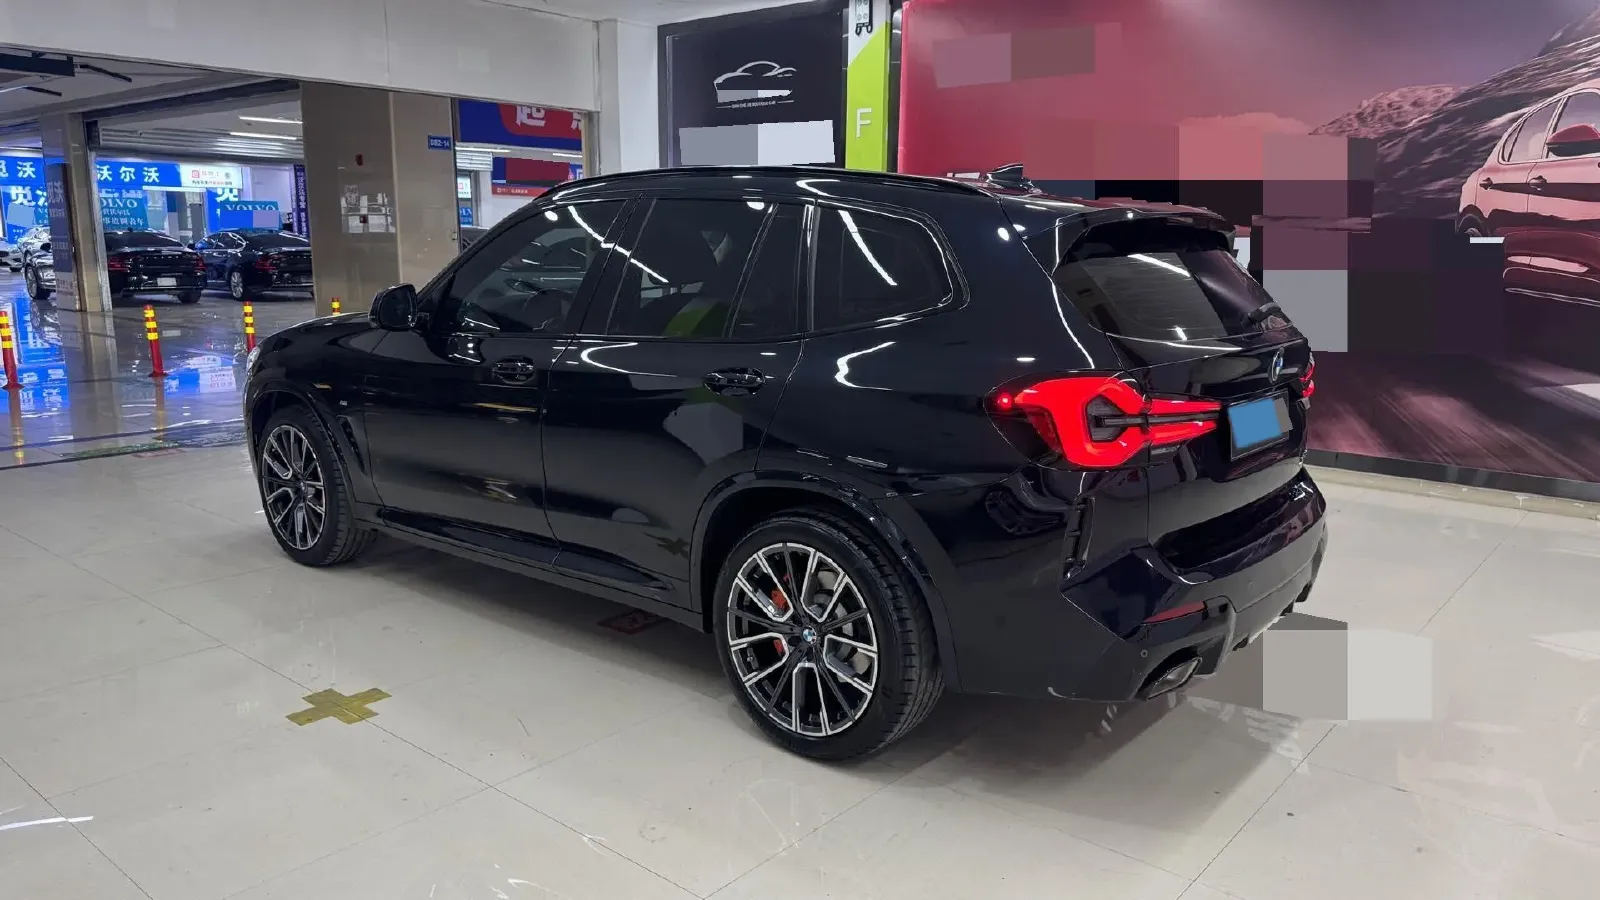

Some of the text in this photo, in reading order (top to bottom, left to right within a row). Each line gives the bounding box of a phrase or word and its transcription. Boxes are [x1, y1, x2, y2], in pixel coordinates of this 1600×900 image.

[856, 107, 872, 138] F
[96, 165, 160, 183] 沃尔沃
[100, 198, 138, 208] OLVO
